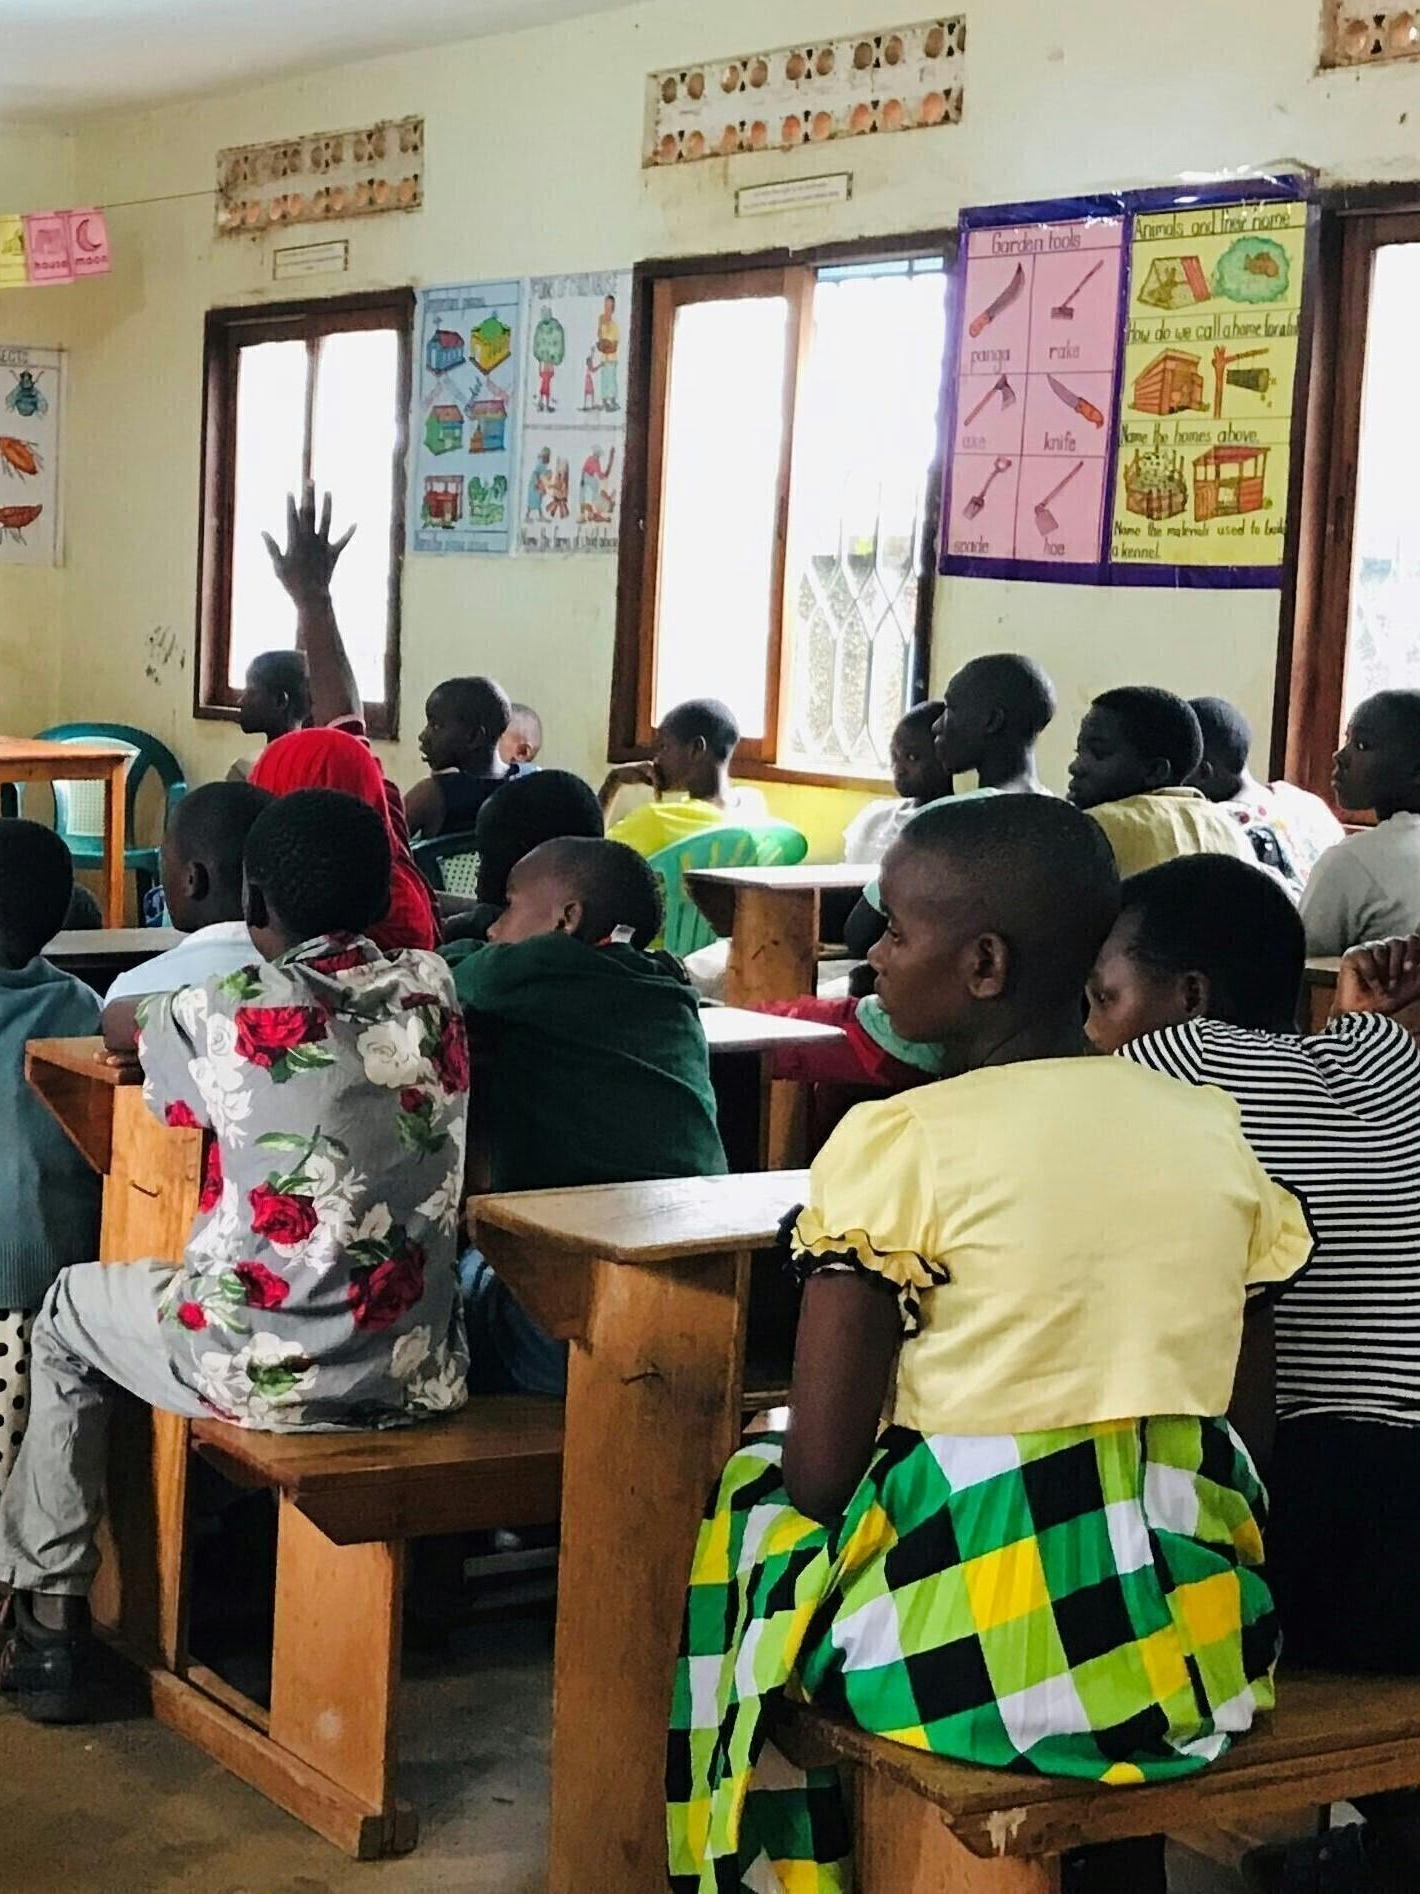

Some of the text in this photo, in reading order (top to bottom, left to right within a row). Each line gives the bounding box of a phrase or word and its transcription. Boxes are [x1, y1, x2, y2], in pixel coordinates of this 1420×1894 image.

[1134, 213, 1184, 241] Animals
[1190, 210, 1216, 235] and
[991, 227, 1082, 254] Garden tools
[75, 255, 107, 266] moon
[1127, 319, 1151, 343] How
[1154, 317, 1171, 341] do
[1175, 325, 1192, 340] we
[1195, 313, 1222, 338] call
[1048, 339, 1080, 360] rake
[970, 347, 1011, 374] panga
[962, 435, 986, 450] axe
[1043, 430, 1077, 452] knife
[1121, 423, 1148, 443] Name
[1153, 422, 1168, 443] the
[1174, 422, 1212, 443] homes
[1113, 520, 1141, 537] Name
[1147, 521, 1162, 537] the
[1166, 520, 1210, 537] materials
[1216, 519, 1245, 536] used
[1250, 519, 1260, 535] to
[1043, 537, 1066, 556] hoe
